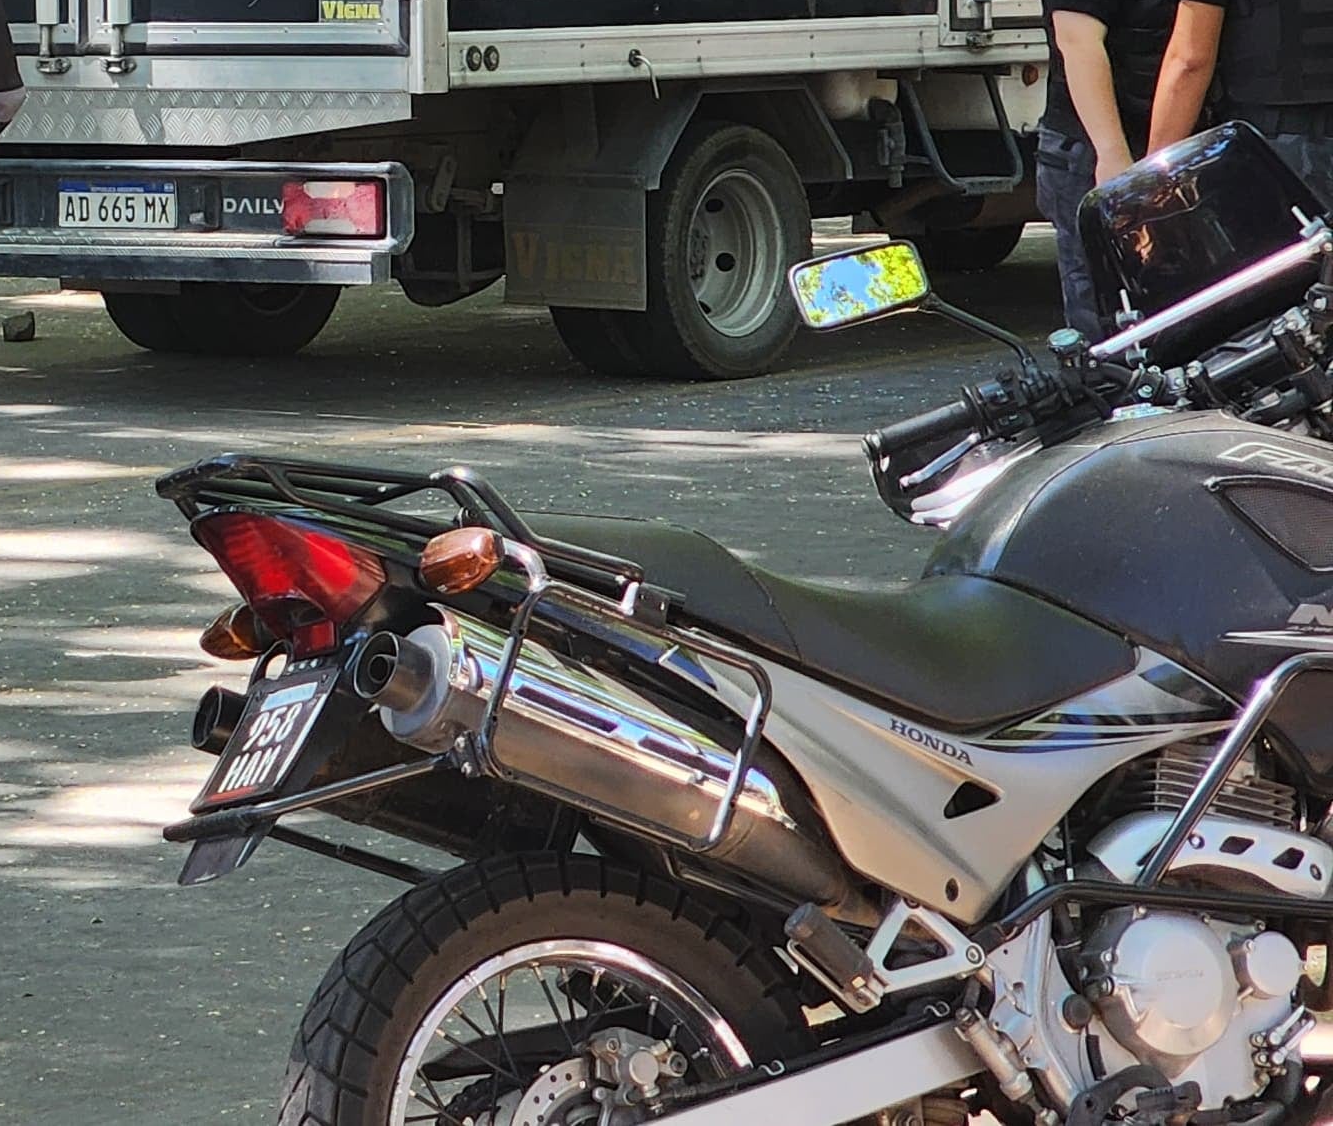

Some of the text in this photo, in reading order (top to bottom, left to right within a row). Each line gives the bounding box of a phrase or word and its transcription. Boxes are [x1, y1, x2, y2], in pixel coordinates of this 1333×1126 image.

[64, 195, 170, 223] AD 665 MX
[241, 702, 303, 752] 958
[889, 718, 974, 767] HONDA
